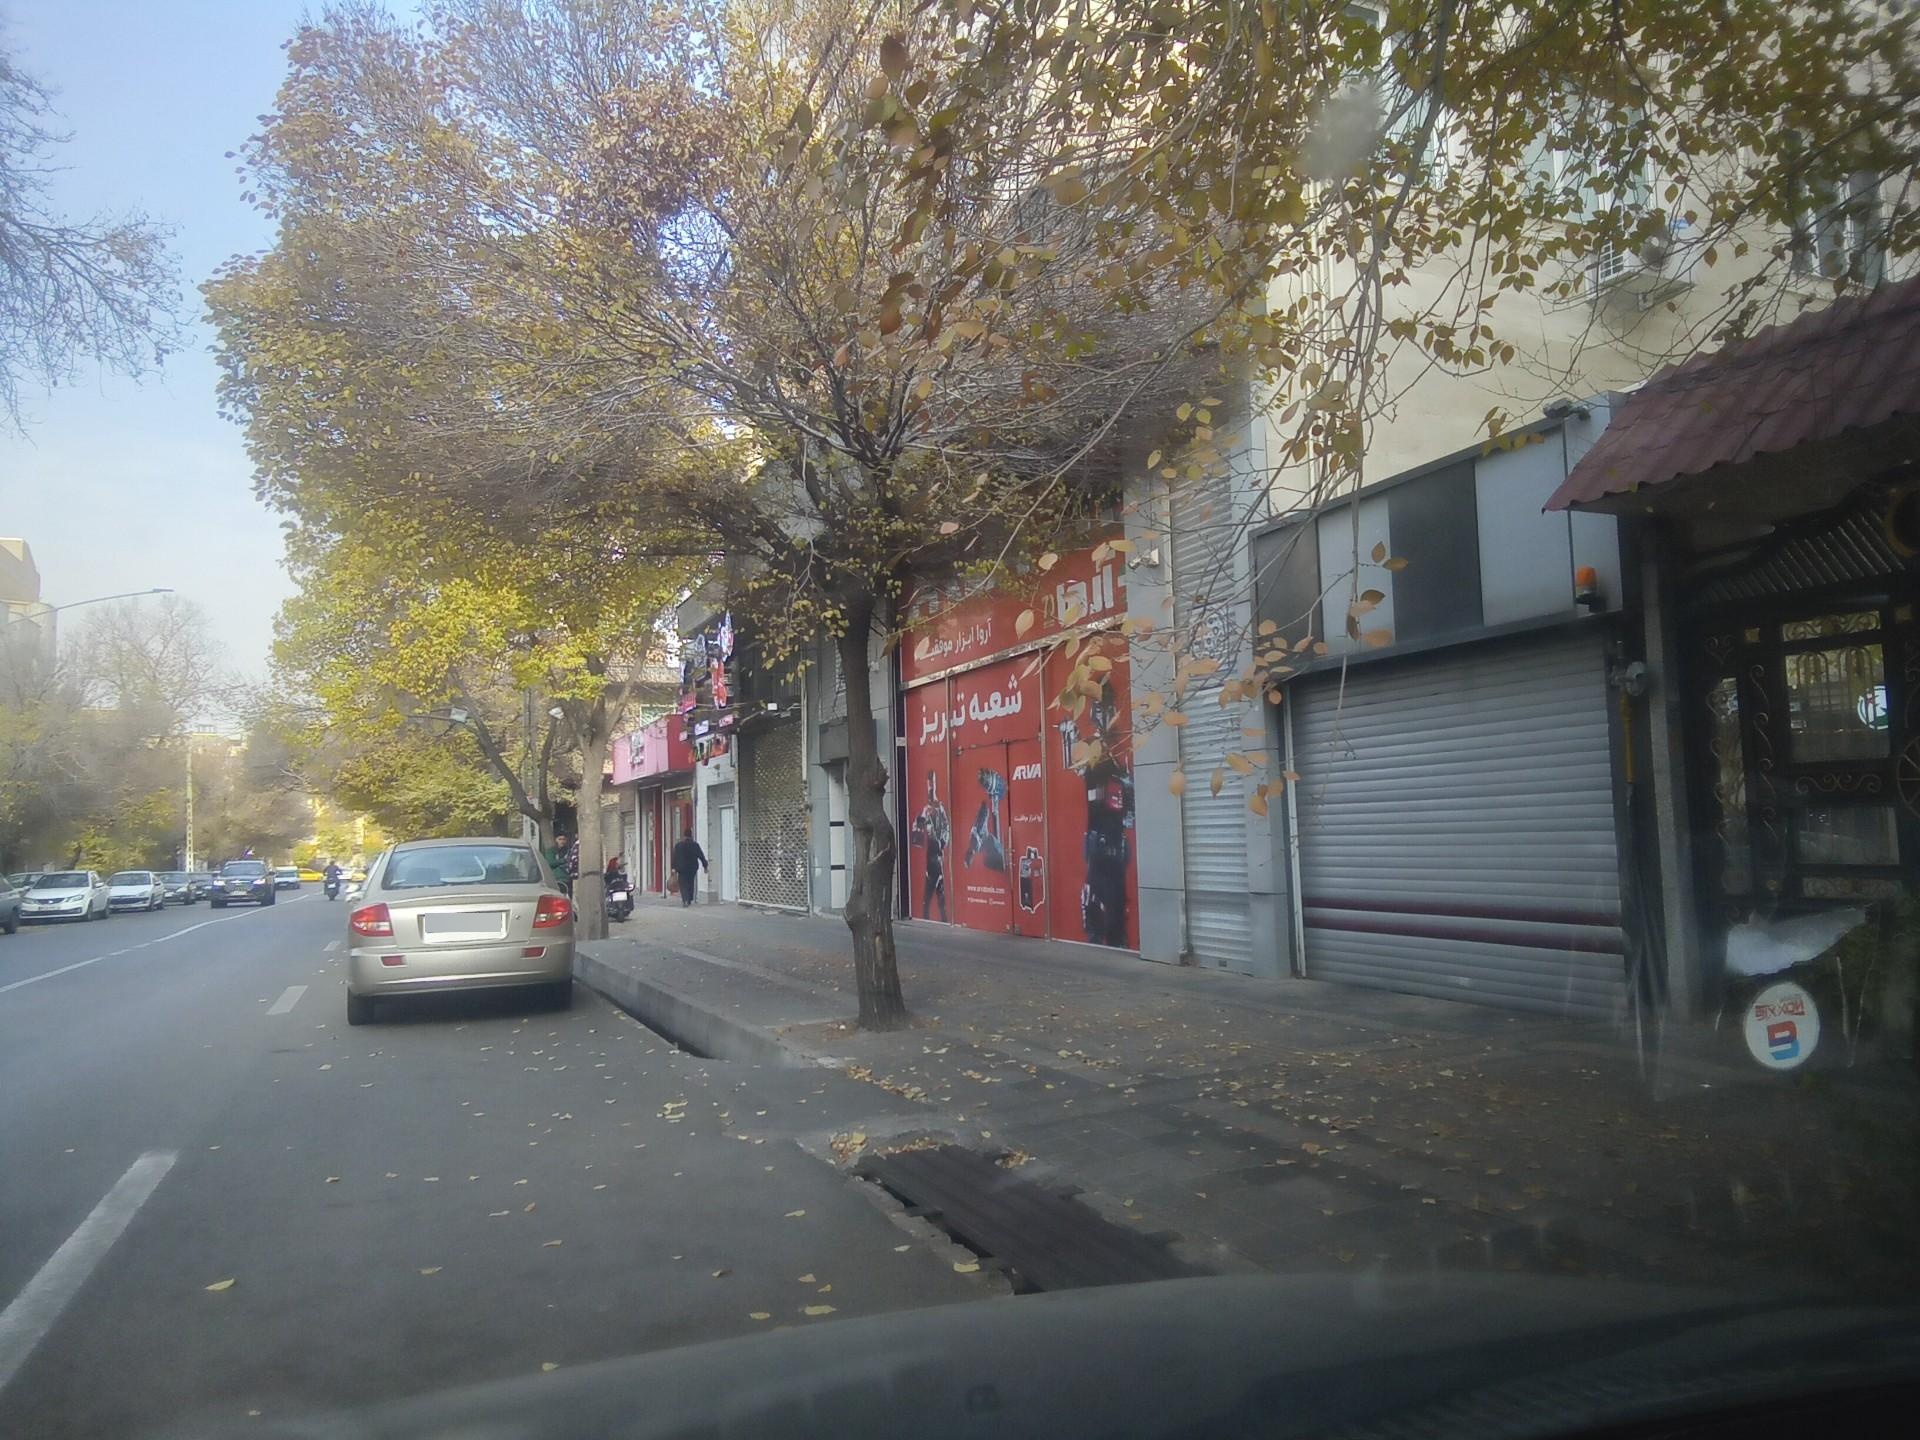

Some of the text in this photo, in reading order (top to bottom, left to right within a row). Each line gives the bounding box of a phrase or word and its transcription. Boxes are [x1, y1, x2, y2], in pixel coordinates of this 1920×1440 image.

[954, 626, 974, 655] ابزار
[976, 617, 992, 646] آروا
[920, 673, 1022, 746] شعبه تبریز
[1012, 763, 1042, 781] ARVA
